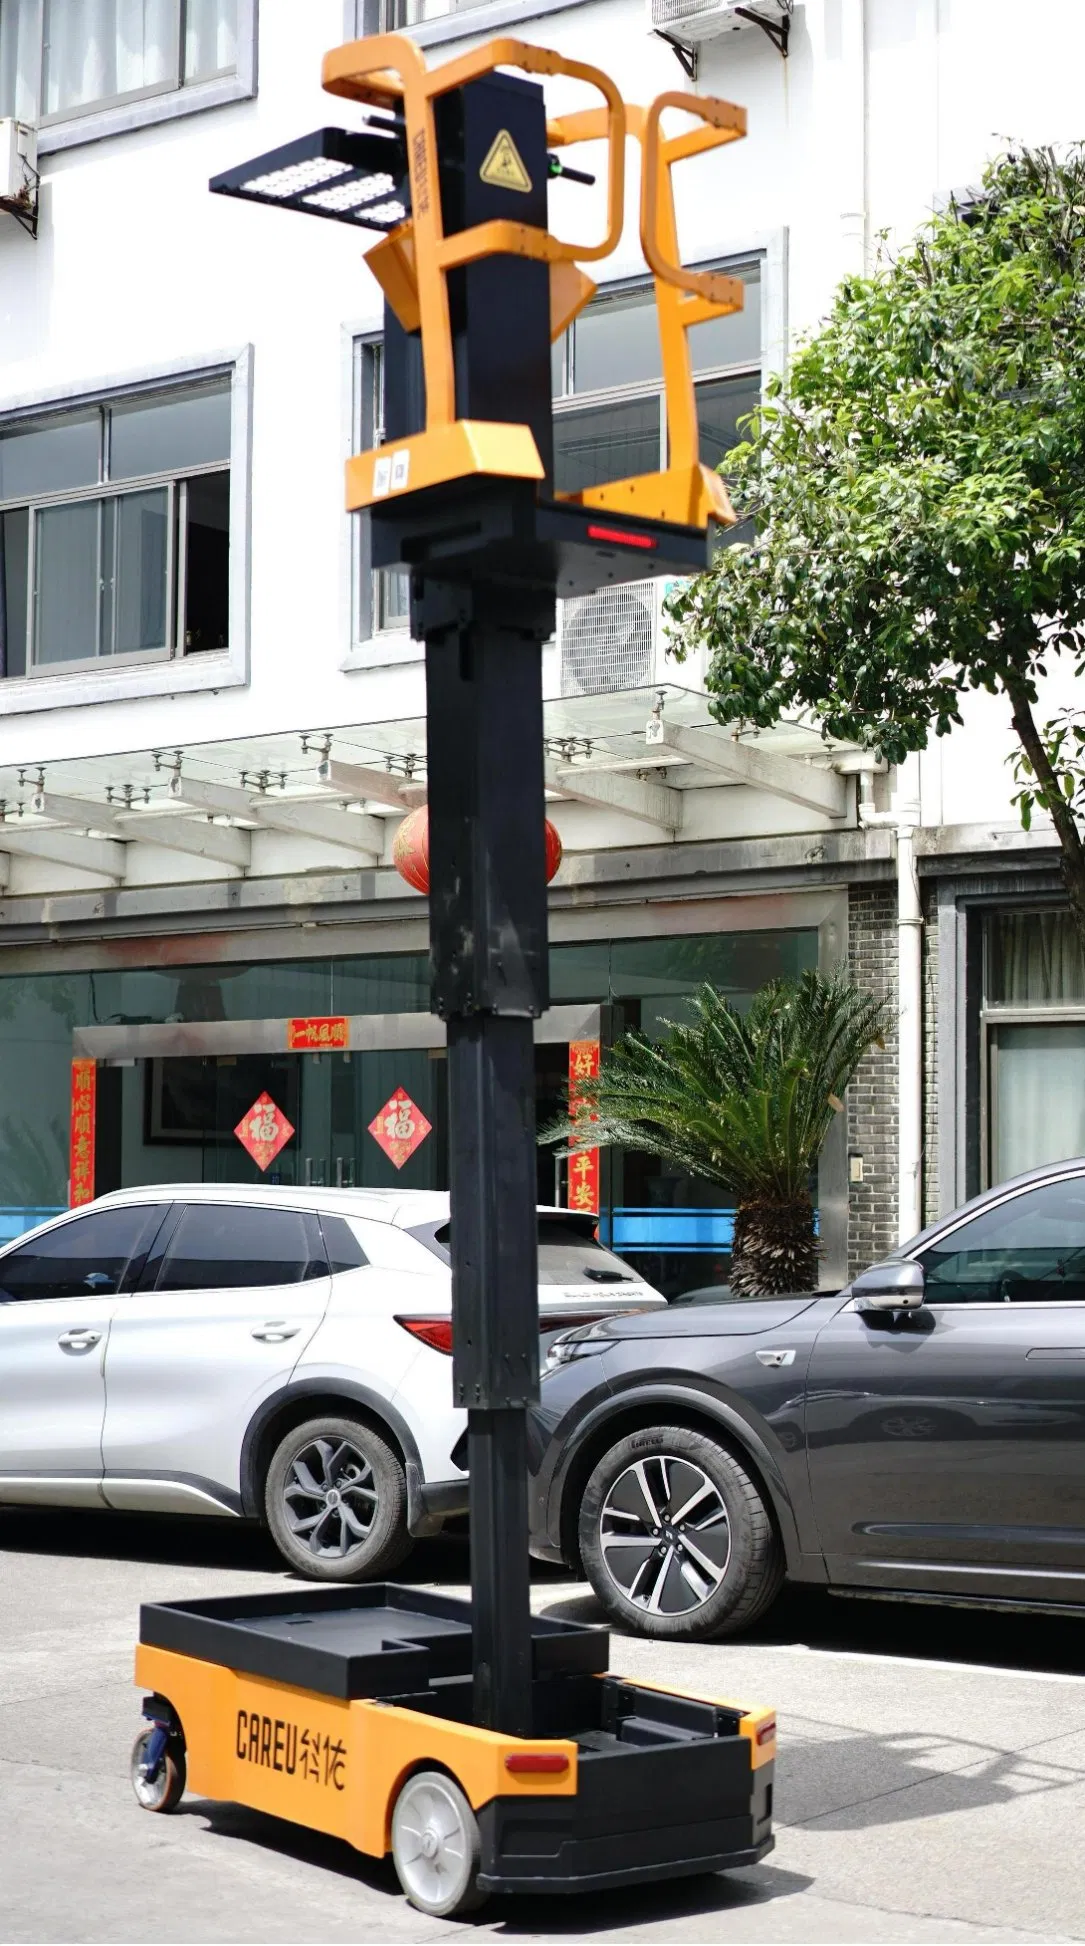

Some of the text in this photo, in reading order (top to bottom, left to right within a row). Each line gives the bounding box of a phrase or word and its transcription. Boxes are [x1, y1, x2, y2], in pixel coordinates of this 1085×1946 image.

[249, 1103, 279, 1142] 福
[384, 1099, 416, 1140] 福
[236, 1709, 298, 1775] CAREU
